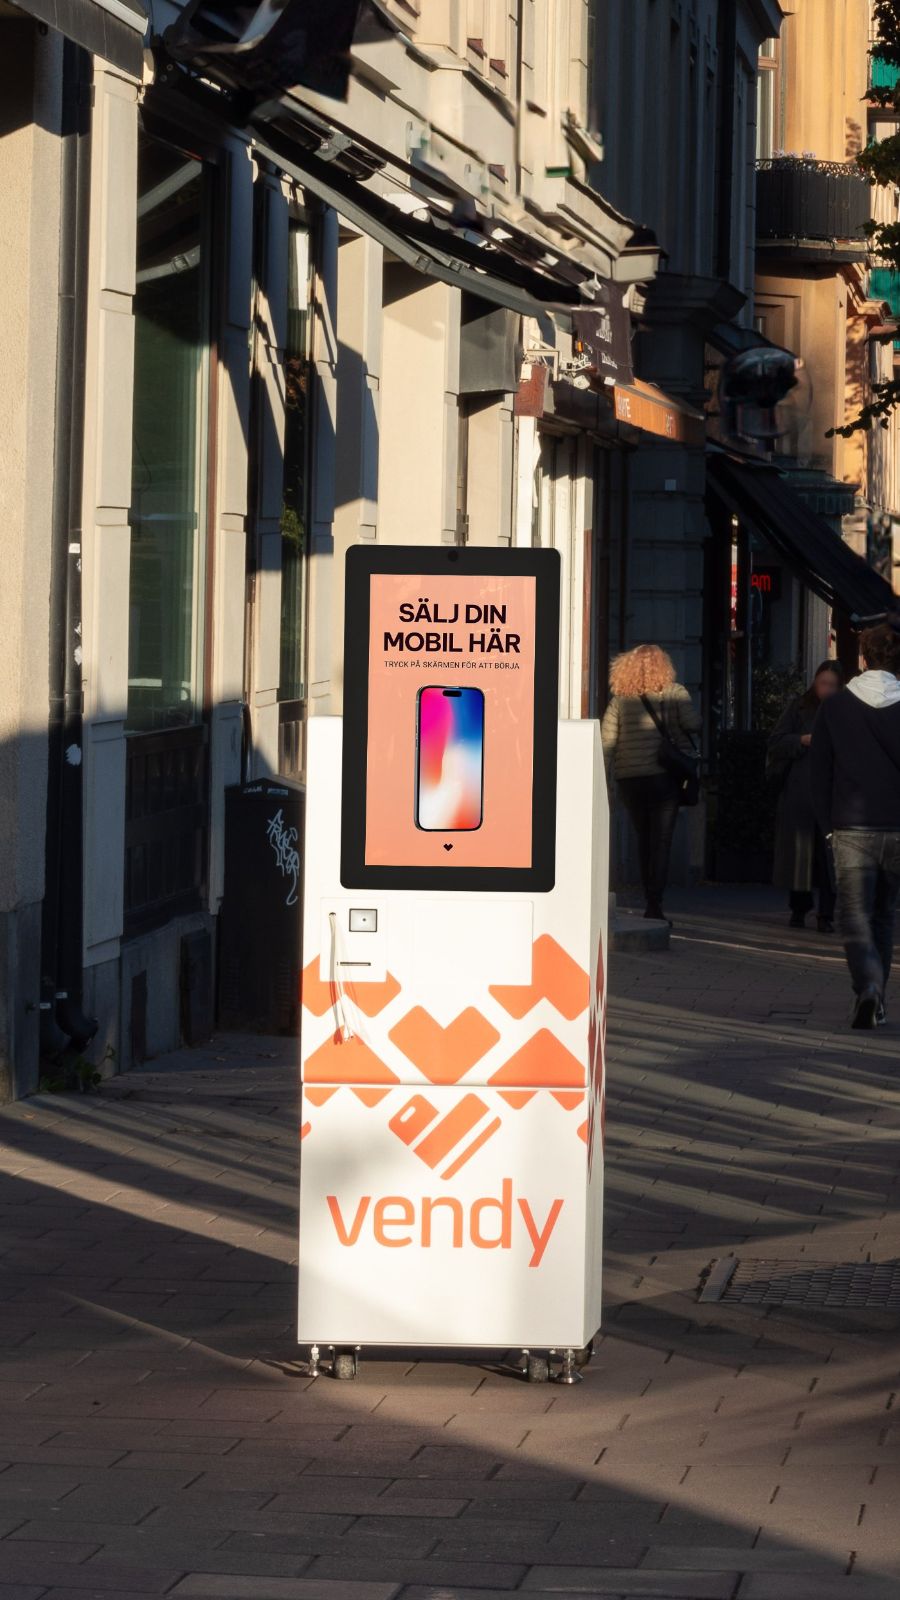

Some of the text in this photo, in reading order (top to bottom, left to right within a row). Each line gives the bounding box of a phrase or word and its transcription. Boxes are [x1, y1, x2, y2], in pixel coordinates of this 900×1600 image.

[399, 598, 507, 624] SÄLJ DIN
[384, 628, 521, 653] MOBIL HÄR
[411, 659, 421, 668] PÅ
[423, 660, 460, 669] SKÄRMEN
[462, 661, 477, 670] FÖR
[478, 662, 493, 670] ATT
[326, 1178, 564, 1267] vendy
